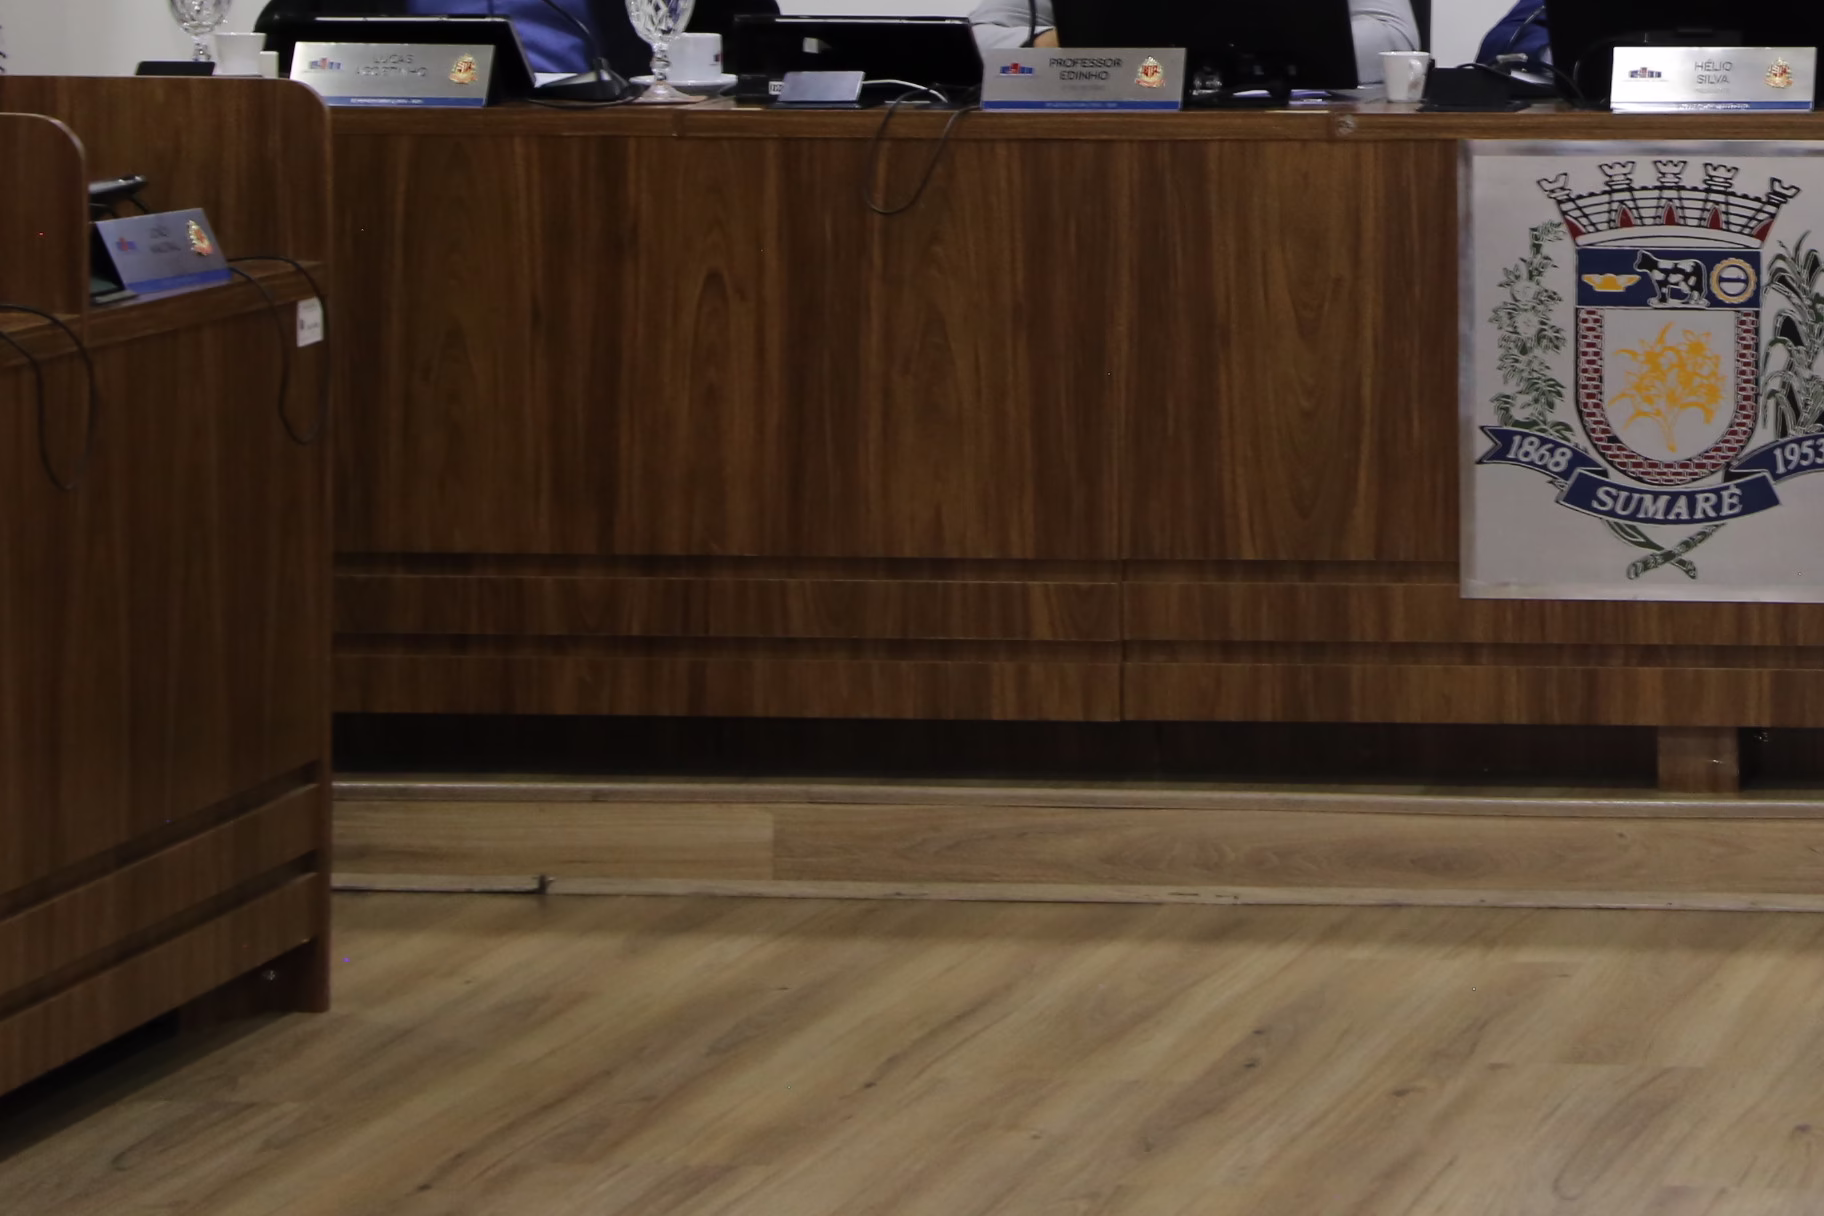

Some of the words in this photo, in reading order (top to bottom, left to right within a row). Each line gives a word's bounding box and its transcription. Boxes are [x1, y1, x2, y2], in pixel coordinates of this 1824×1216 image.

[1049, 58, 1122, 68] PROFESSOR
[1060, 71, 1109, 80] EDINHO
[1697, 75, 1730, 84] SILVA
[1506, 435, 1573, 472] 1868
[1591, 484, 1743, 519] SUMARÉ
